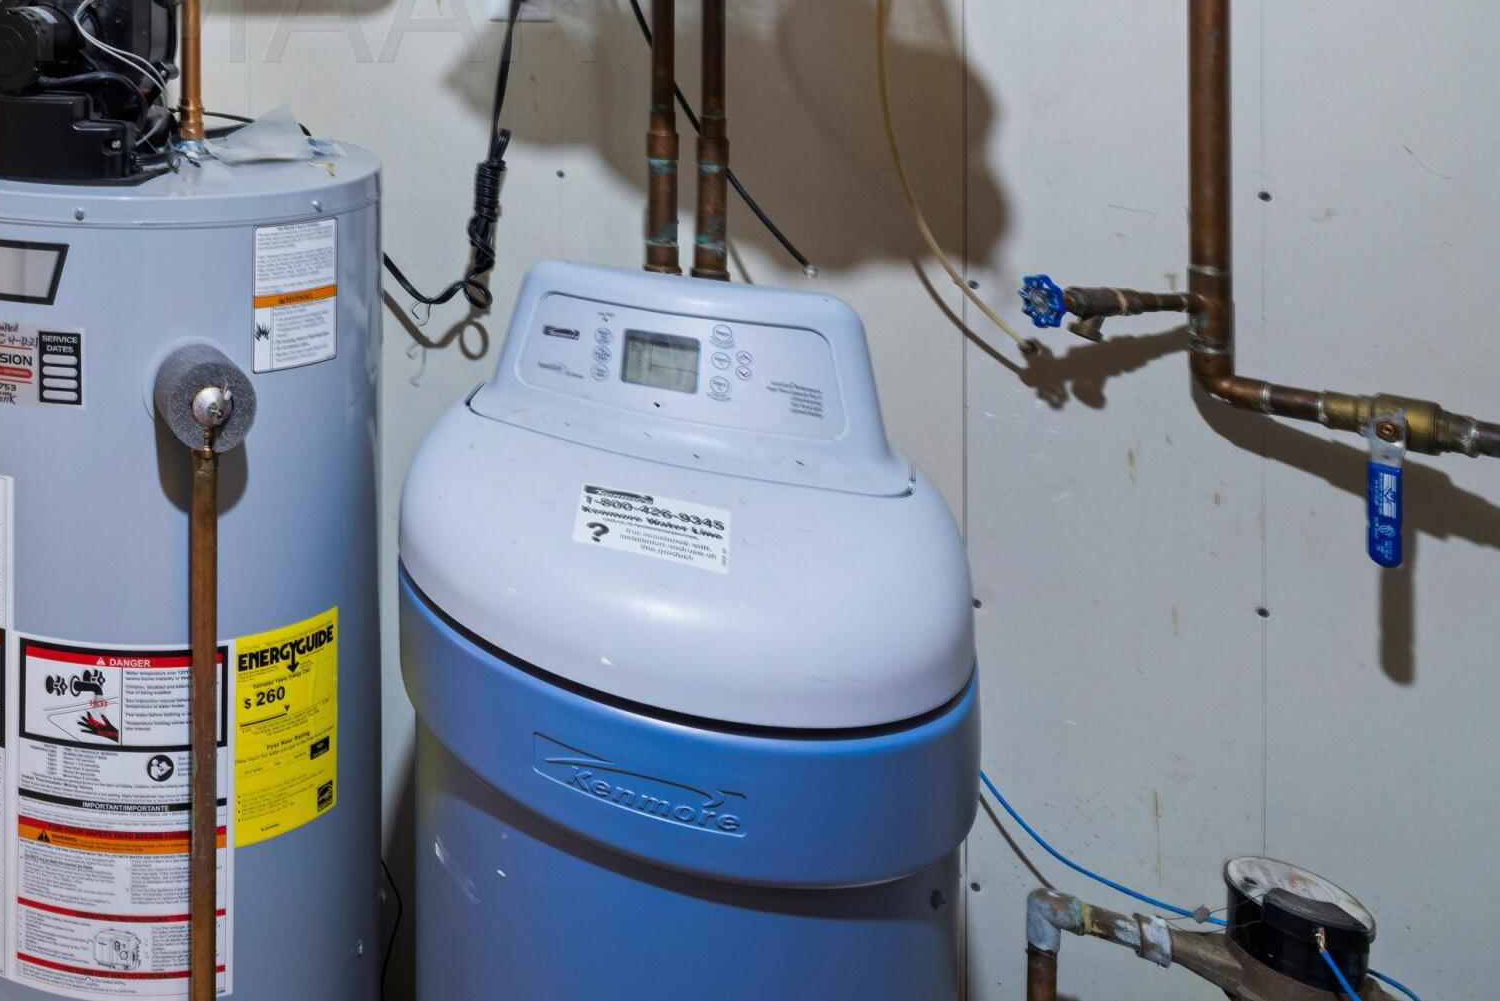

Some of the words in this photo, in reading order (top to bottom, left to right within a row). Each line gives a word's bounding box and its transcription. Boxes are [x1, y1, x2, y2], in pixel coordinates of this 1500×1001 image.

[41, 334, 78, 344] SERVICE
[46, 344, 74, 353] DATES
[585, 494, 725, 531] 1-800-426-9345
[581, 504, 643, 522] Kenmore
[647, 517, 689, 532] Water
[691, 525, 724, 541] Line
[238, 624, 334, 673] ENERGYGUIDE
[109, 658, 151, 668] DANGER
[244, 698, 252, 709] $
[256, 686, 285, 706] 260
[82, 801, 170, 812] IMPORTANT/IMPORTANTE
[566, 765, 742, 832] Kenmore
[116, 831, 134, 839] READ
